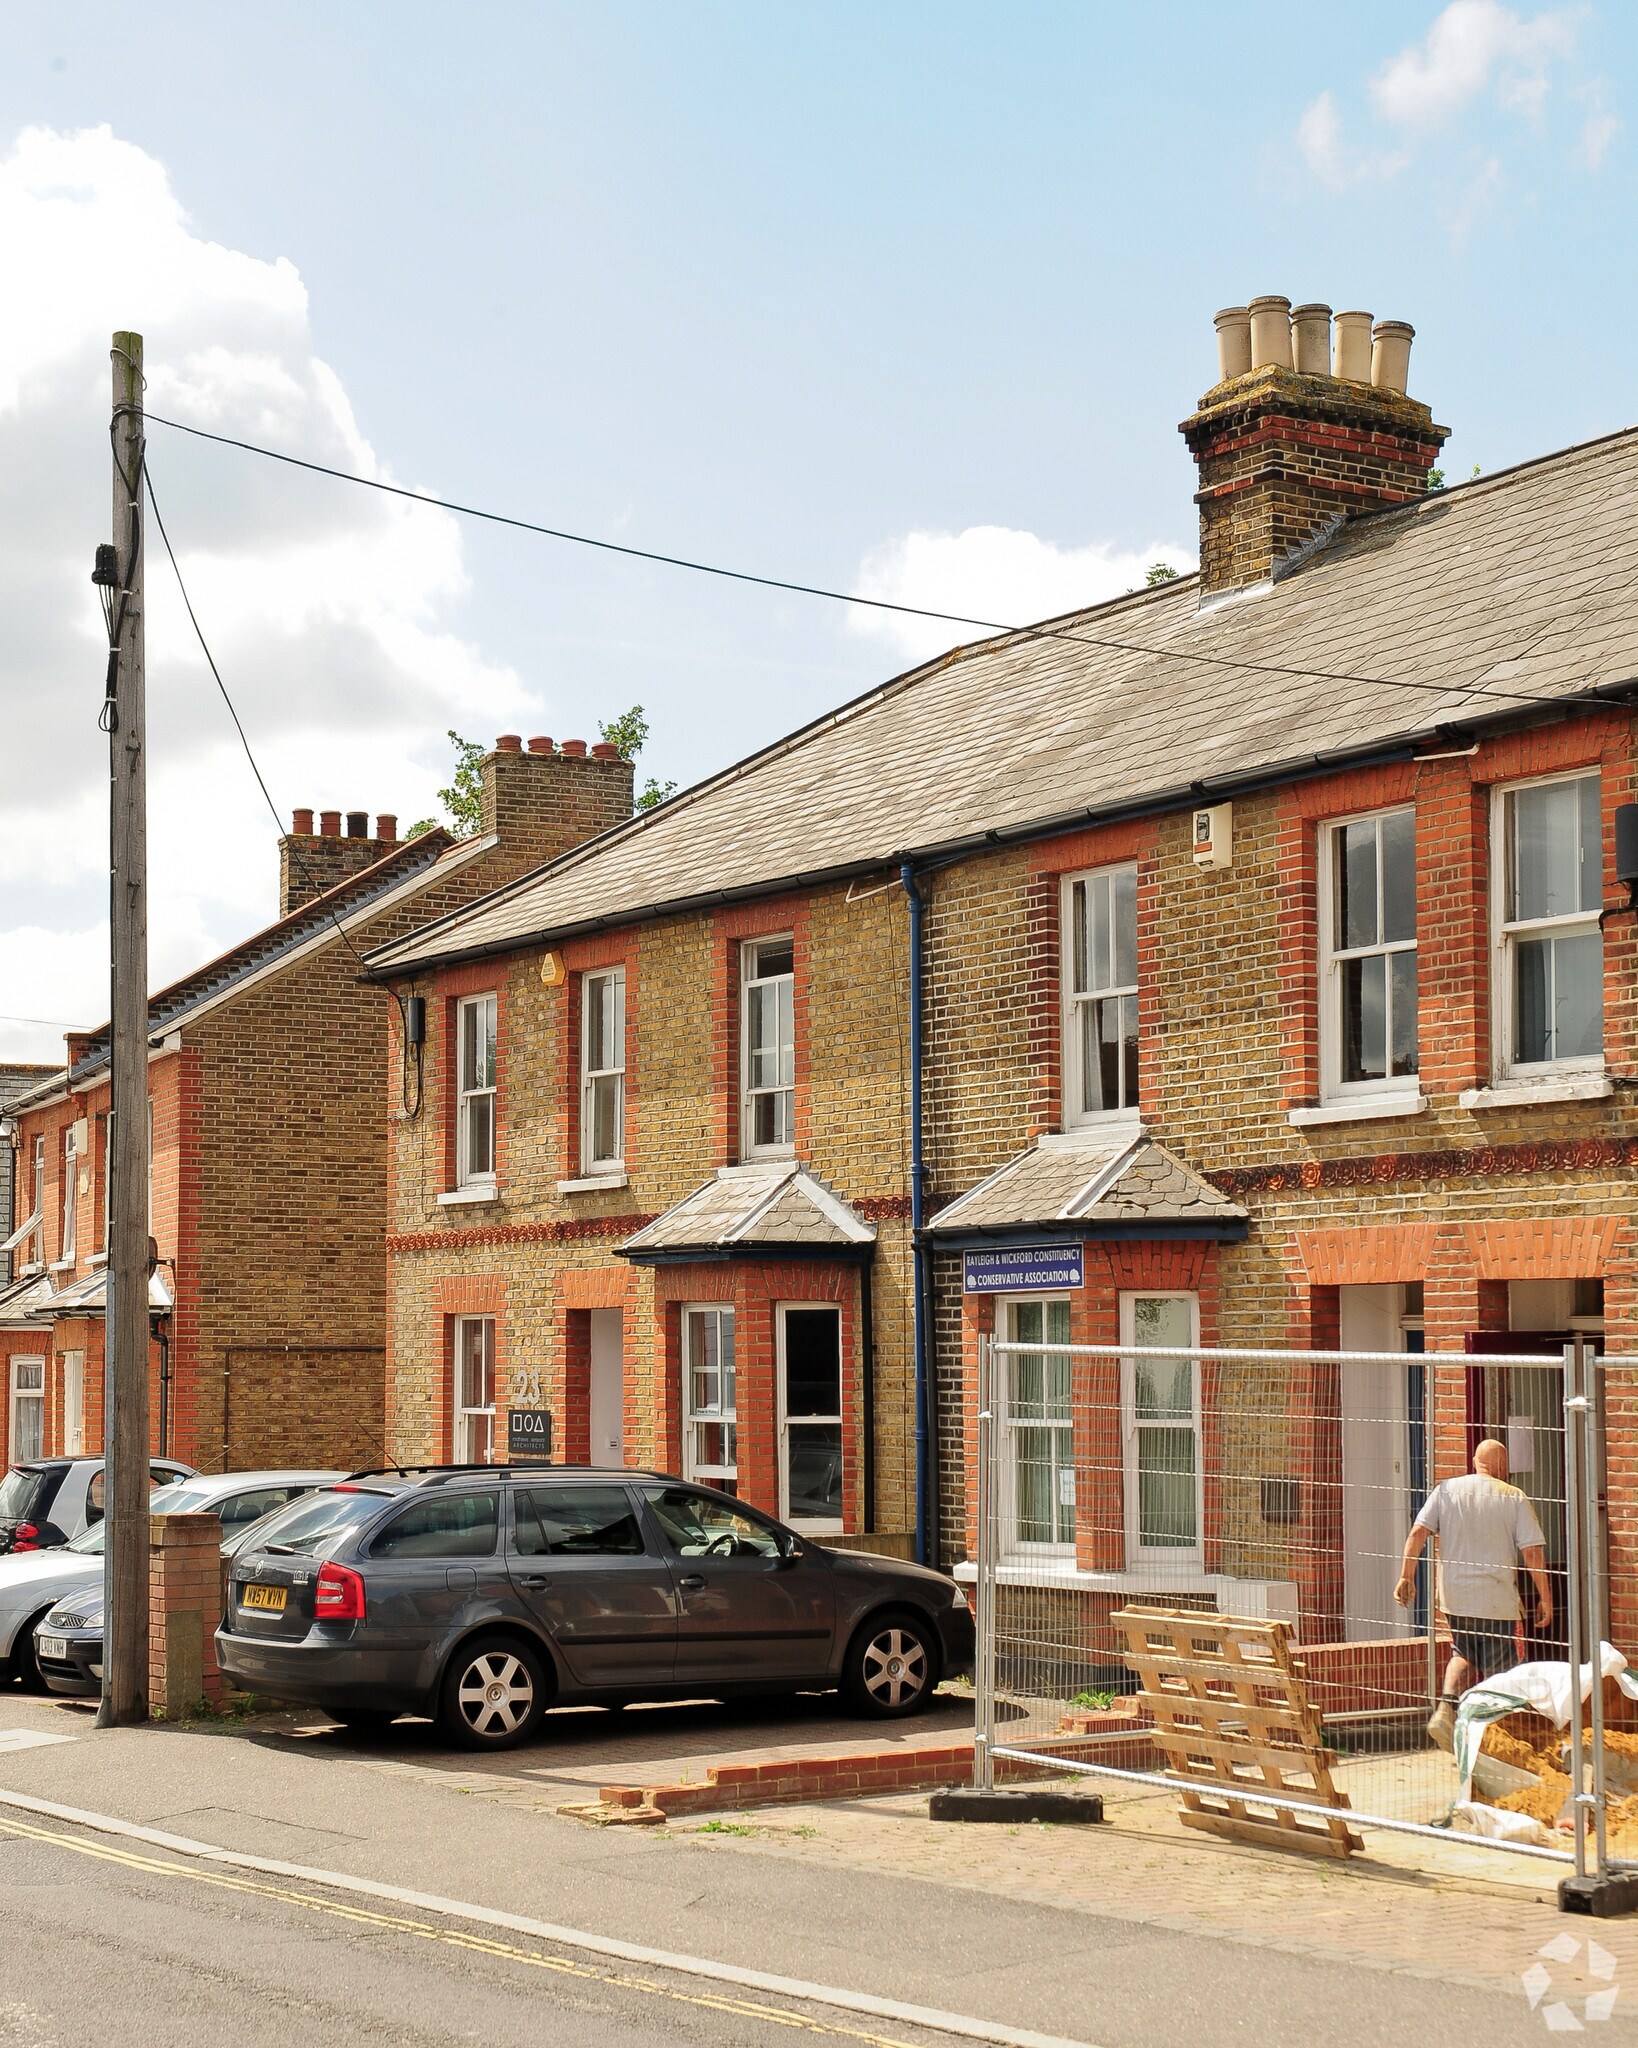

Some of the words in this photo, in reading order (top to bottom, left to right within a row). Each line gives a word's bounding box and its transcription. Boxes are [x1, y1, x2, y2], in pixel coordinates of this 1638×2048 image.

[966, 1254, 995, 1266] RAYLEIGH
[995, 1254, 1000, 1265] &
[1001, 1251, 1033, 1265] WICKFORD
[1034, 1249, 1080, 1262] CONSTITUENCY
[977, 1272, 1023, 1286] CONSERVATIVE
[1024, 1269, 1069, 1284] ASSOCIATION
[516, 1369, 540, 1404] 23
